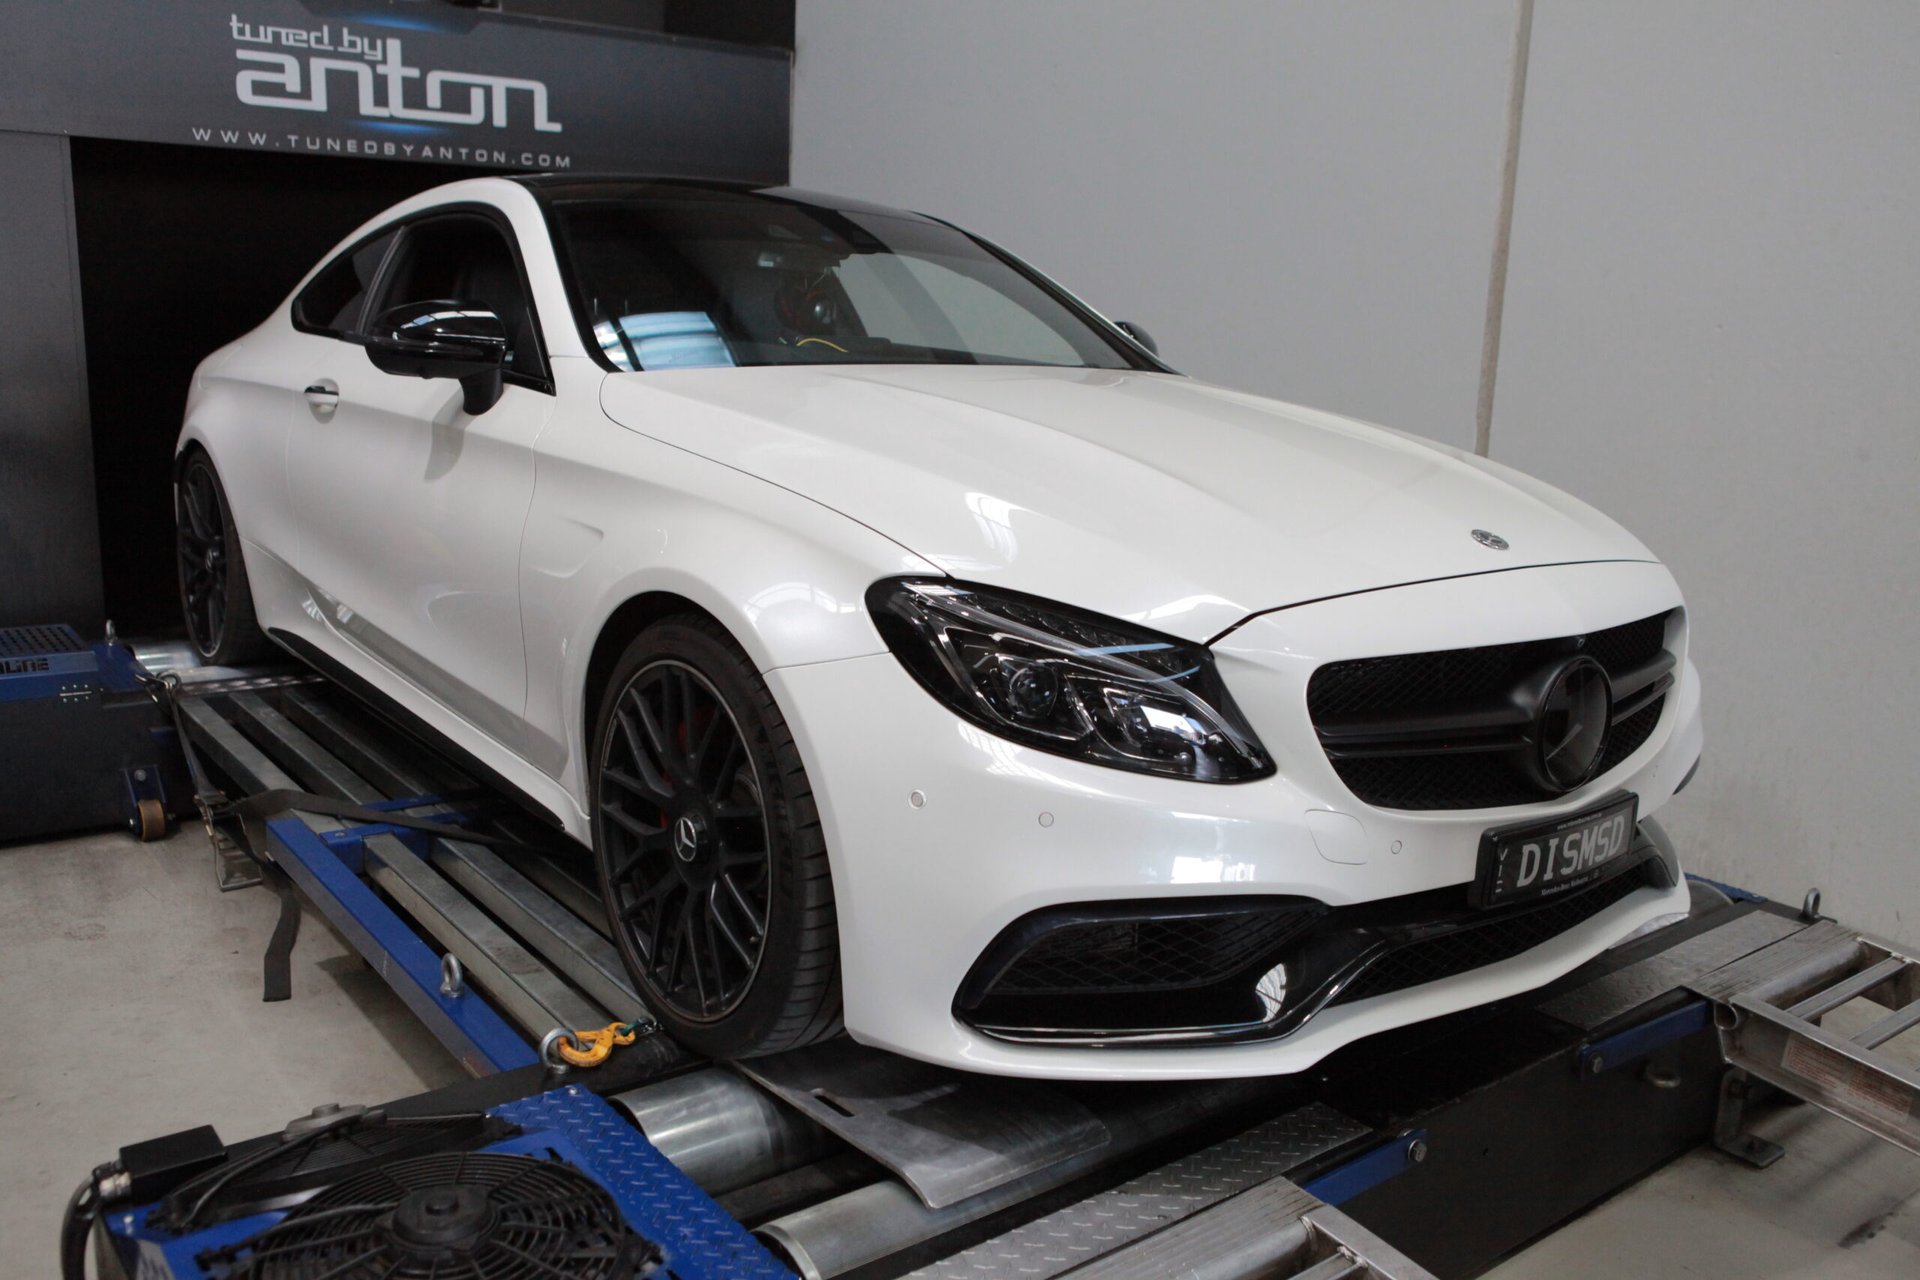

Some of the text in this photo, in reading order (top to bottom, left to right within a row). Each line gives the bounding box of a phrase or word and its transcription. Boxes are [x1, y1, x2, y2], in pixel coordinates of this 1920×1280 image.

[230, 14, 383, 61] tuned by
[235, 38, 563, 133] anton
[192, 127, 572, 168] WWW.TUNEDBYANTON.COM
[1516, 815, 1625, 887] DISMSD
